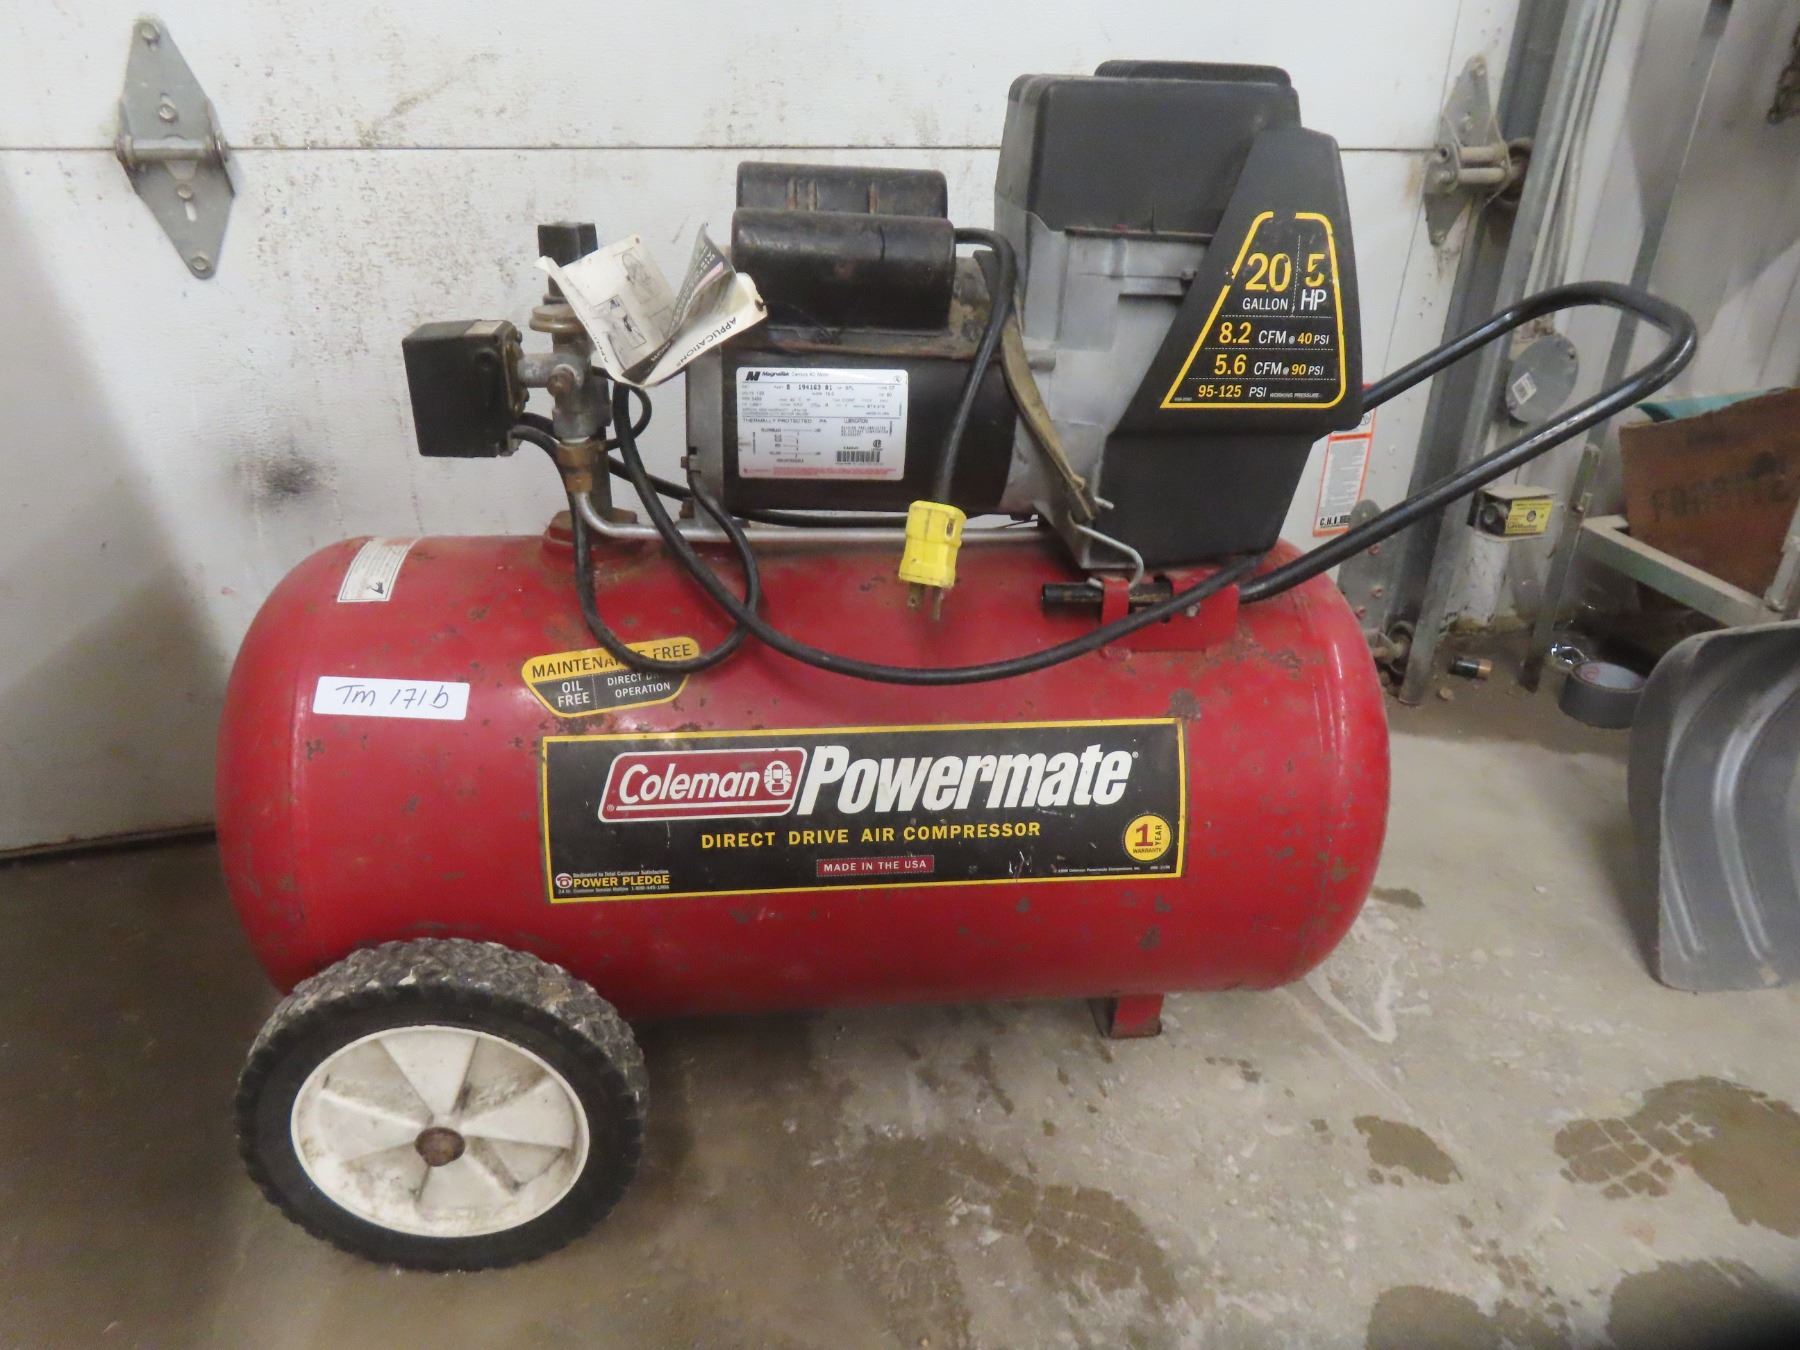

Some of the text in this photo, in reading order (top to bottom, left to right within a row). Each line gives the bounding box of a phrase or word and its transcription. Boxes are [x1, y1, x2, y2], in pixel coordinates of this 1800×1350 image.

[1245, 252, 1292, 292] 20
[1305, 253, 1325, 287] 5
[1242, 298, 1289, 311] GALLON
[1300, 289, 1327, 311] HP
[1219, 321, 1252, 344] 8.2
[1258, 330, 1286, 344] CFM
[1297, 335, 1313, 345] 40
[1313, 335, 1330, 345] PSI
[1214, 354, 1247, 376] 5.6
[1254, 361, 1282, 375] CFM
[1291, 364, 1307, 376] 90
[1308, 366, 1324, 376] PSI
[1198, 384, 1242, 398] 95-125
[1249, 386, 1267, 398] PSI
[653, 643, 693, 660] FREE
[562, 680, 583, 693] OIL
[607, 673, 642, 686] DIRECT
[615, 682, 671, 698] OPERATION
[557, 691, 591, 708] FREE
[619, 763, 760, 804] Coleman
[797, 744, 1132, 815] Powermate
[701, 822, 1041, 849] DIRECT DRIVE AIR COMPRESSOR
[1135, 823, 1153, 847] 1
[1154, 824, 1162, 846] YEAR
[823, 860, 927, 873] MADE IN THE USA
[573, 875, 670, 888] POWER PLEDGE
